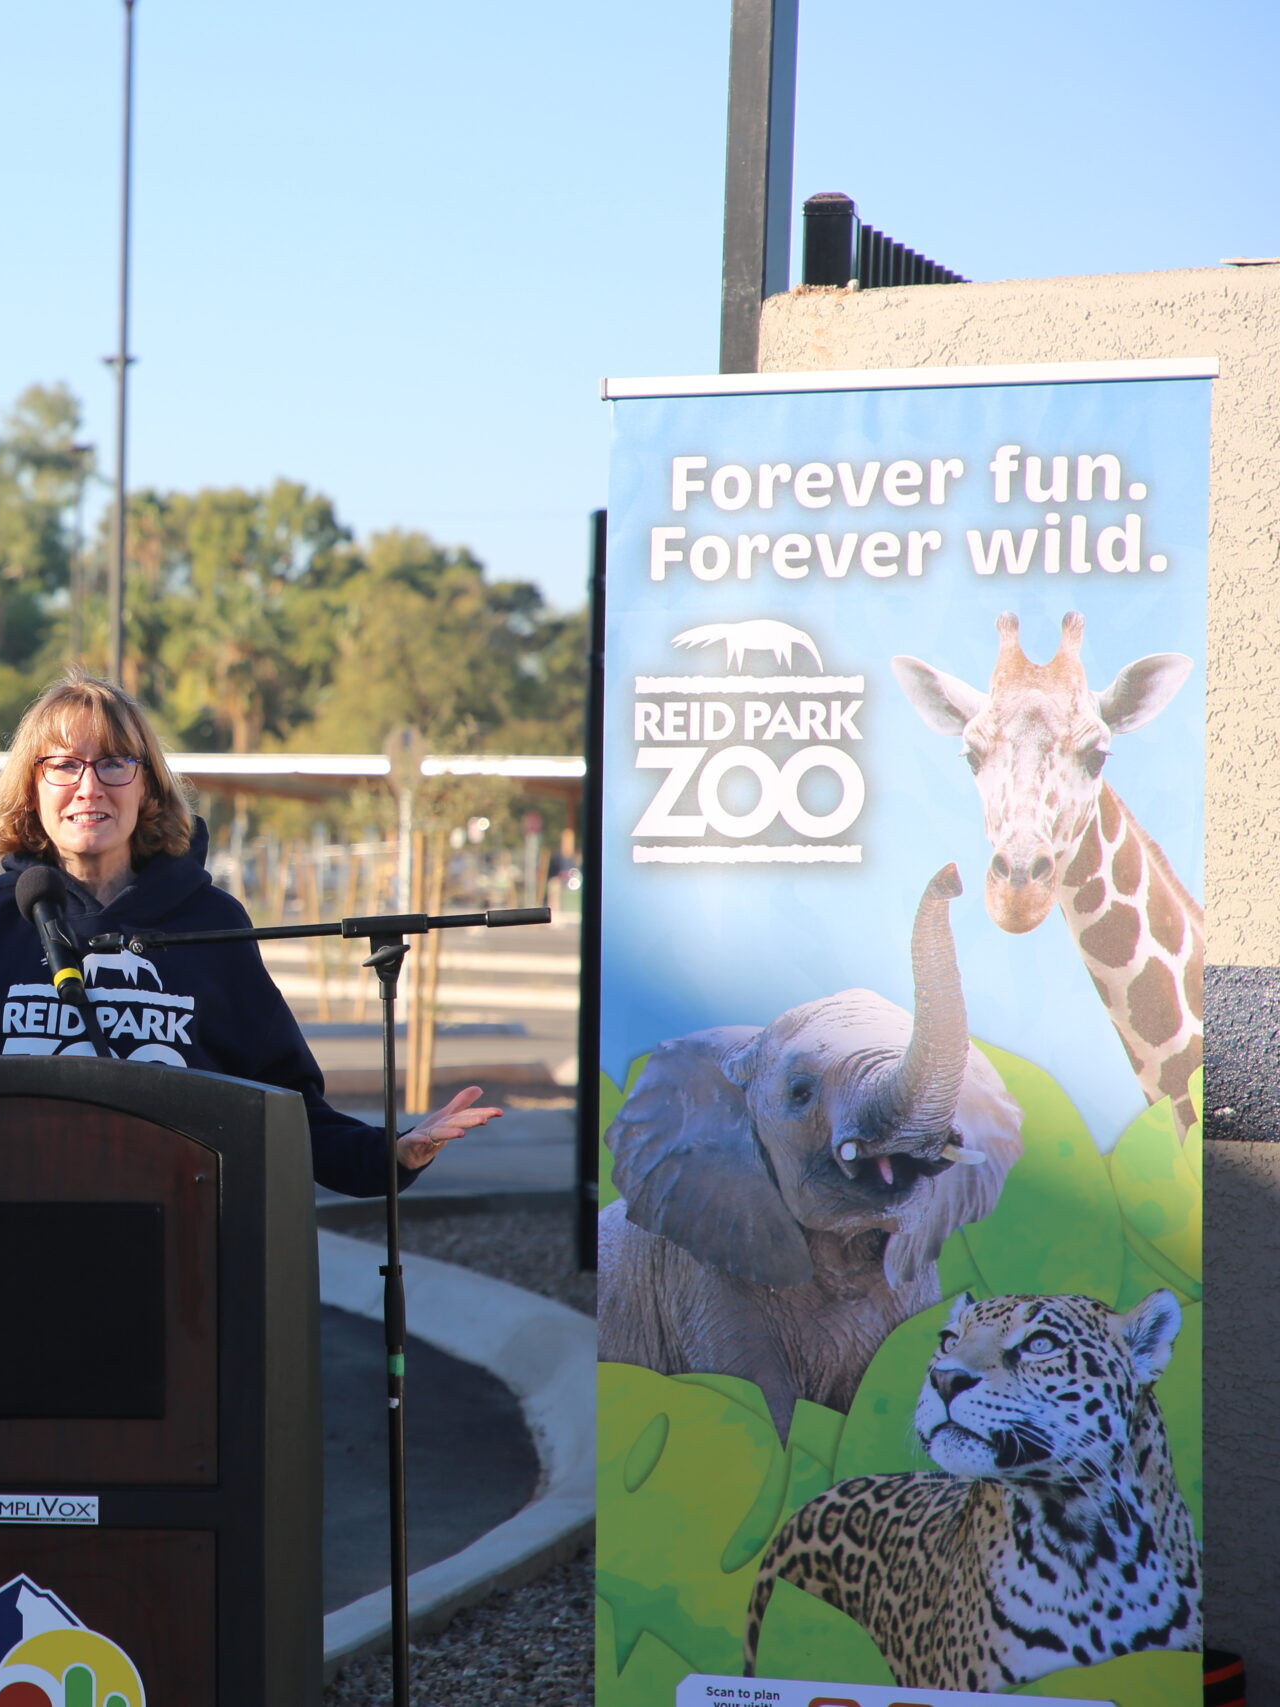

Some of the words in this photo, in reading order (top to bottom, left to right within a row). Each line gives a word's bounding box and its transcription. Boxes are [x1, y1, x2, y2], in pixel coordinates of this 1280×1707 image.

[671, 455, 964, 511] Forever
[989, 445, 1147, 503] fun.
[649, 525, 942, 581] Forever
[967, 513, 1168, 576] wild.
[634, 701, 736, 741] REID
[744, 700, 864, 740] PARK
[630, 745, 865, 838] ZOO
[2, 1002, 86, 1037] REID
[96, 1006, 194, 1045] PARK
[706, 1686, 734, 1697] Scan
[738, 1688, 751, 1699] to
[754, 1690, 780, 1701] plan
